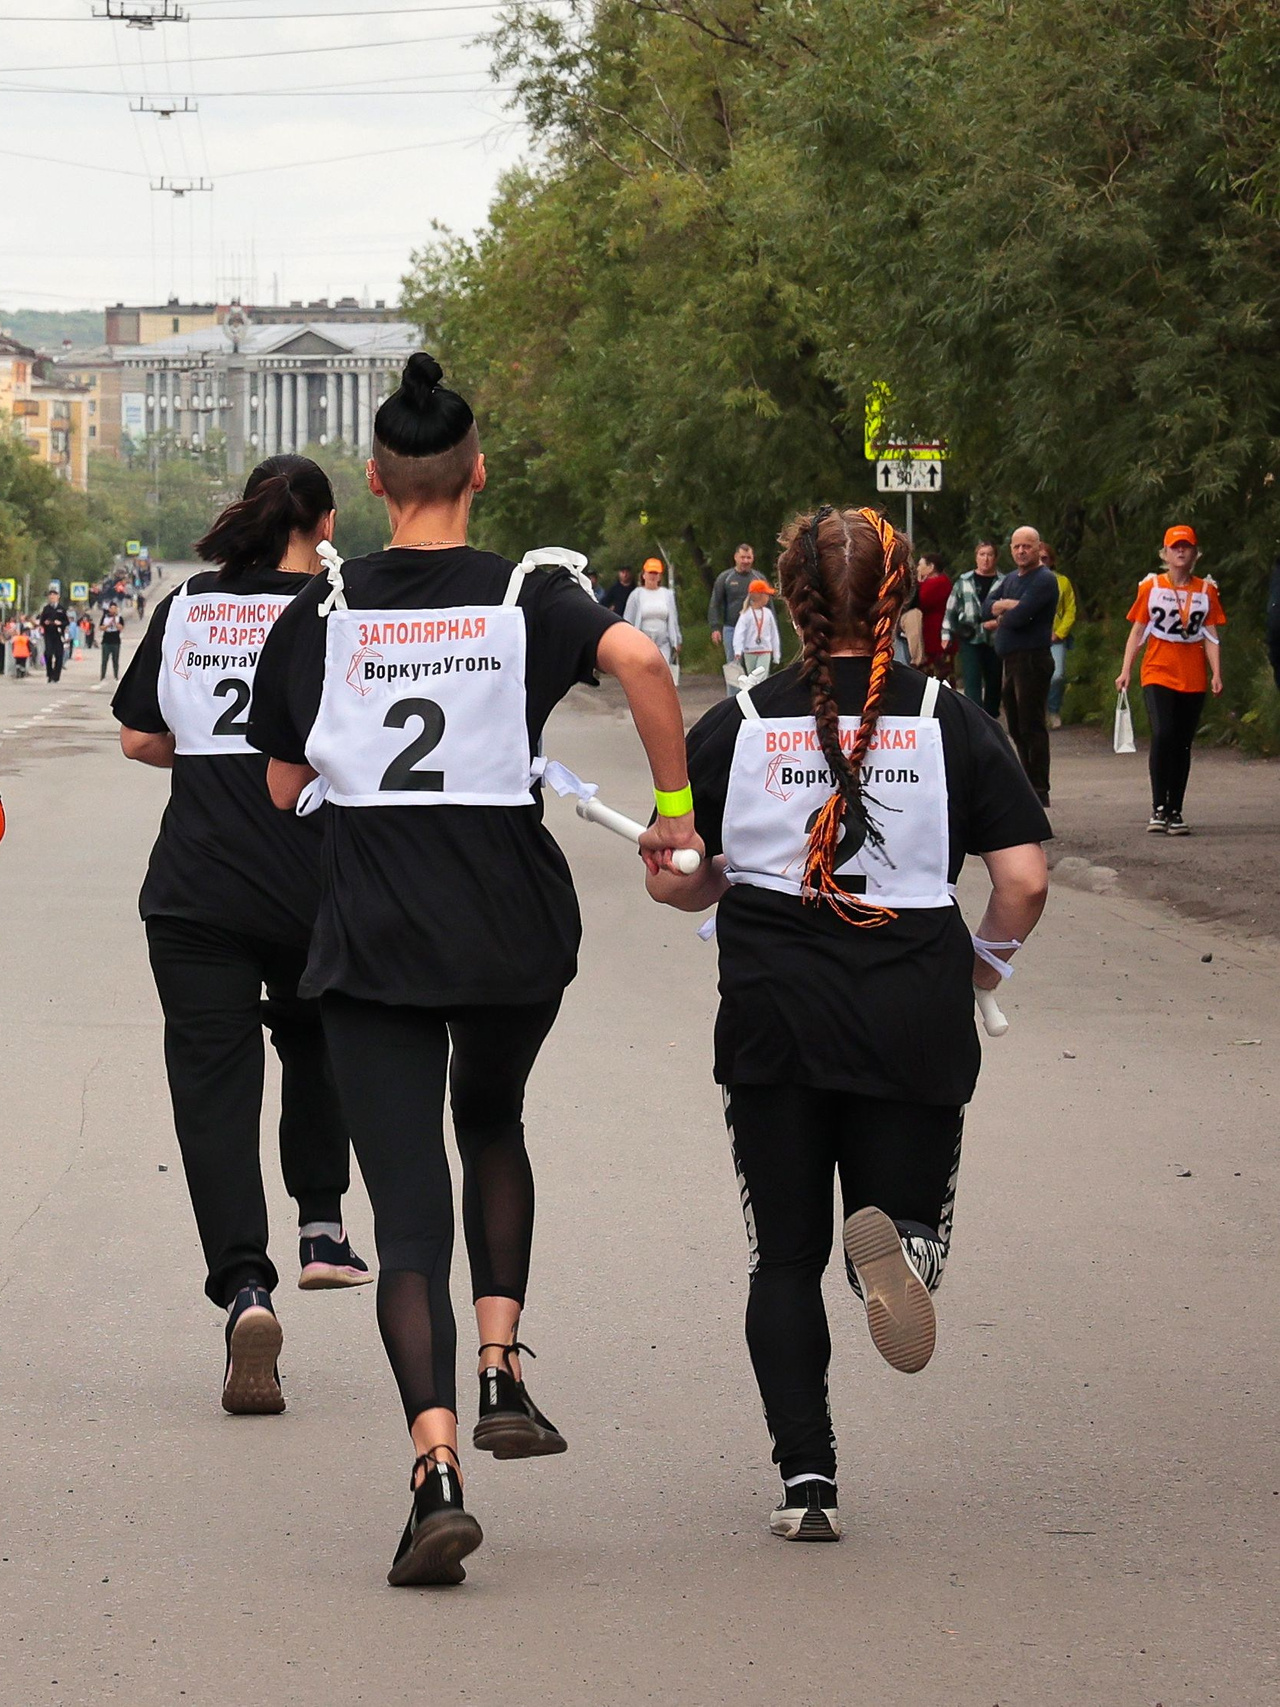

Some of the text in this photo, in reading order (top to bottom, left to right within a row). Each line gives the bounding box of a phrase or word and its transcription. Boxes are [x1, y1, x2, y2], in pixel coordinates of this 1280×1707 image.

[186, 603, 286, 623] ЮНЬЯГИНСК
[1151, 606, 1205, 635] 228
[208, 626, 266, 646] РАЗРЕЗ
[358, 617, 486, 646] ЗАПОЛЯРНАЯ
[187, 652, 258, 669] ВоркутаУ
[364, 656, 502, 682] ВоркутаУголь
[212, 678, 251, 735] 2
[378, 697, 446, 792] 2
[766, 729, 917, 752] ВОРКИСКАЯ
[781, 766, 920, 787] ВоркуУголь
